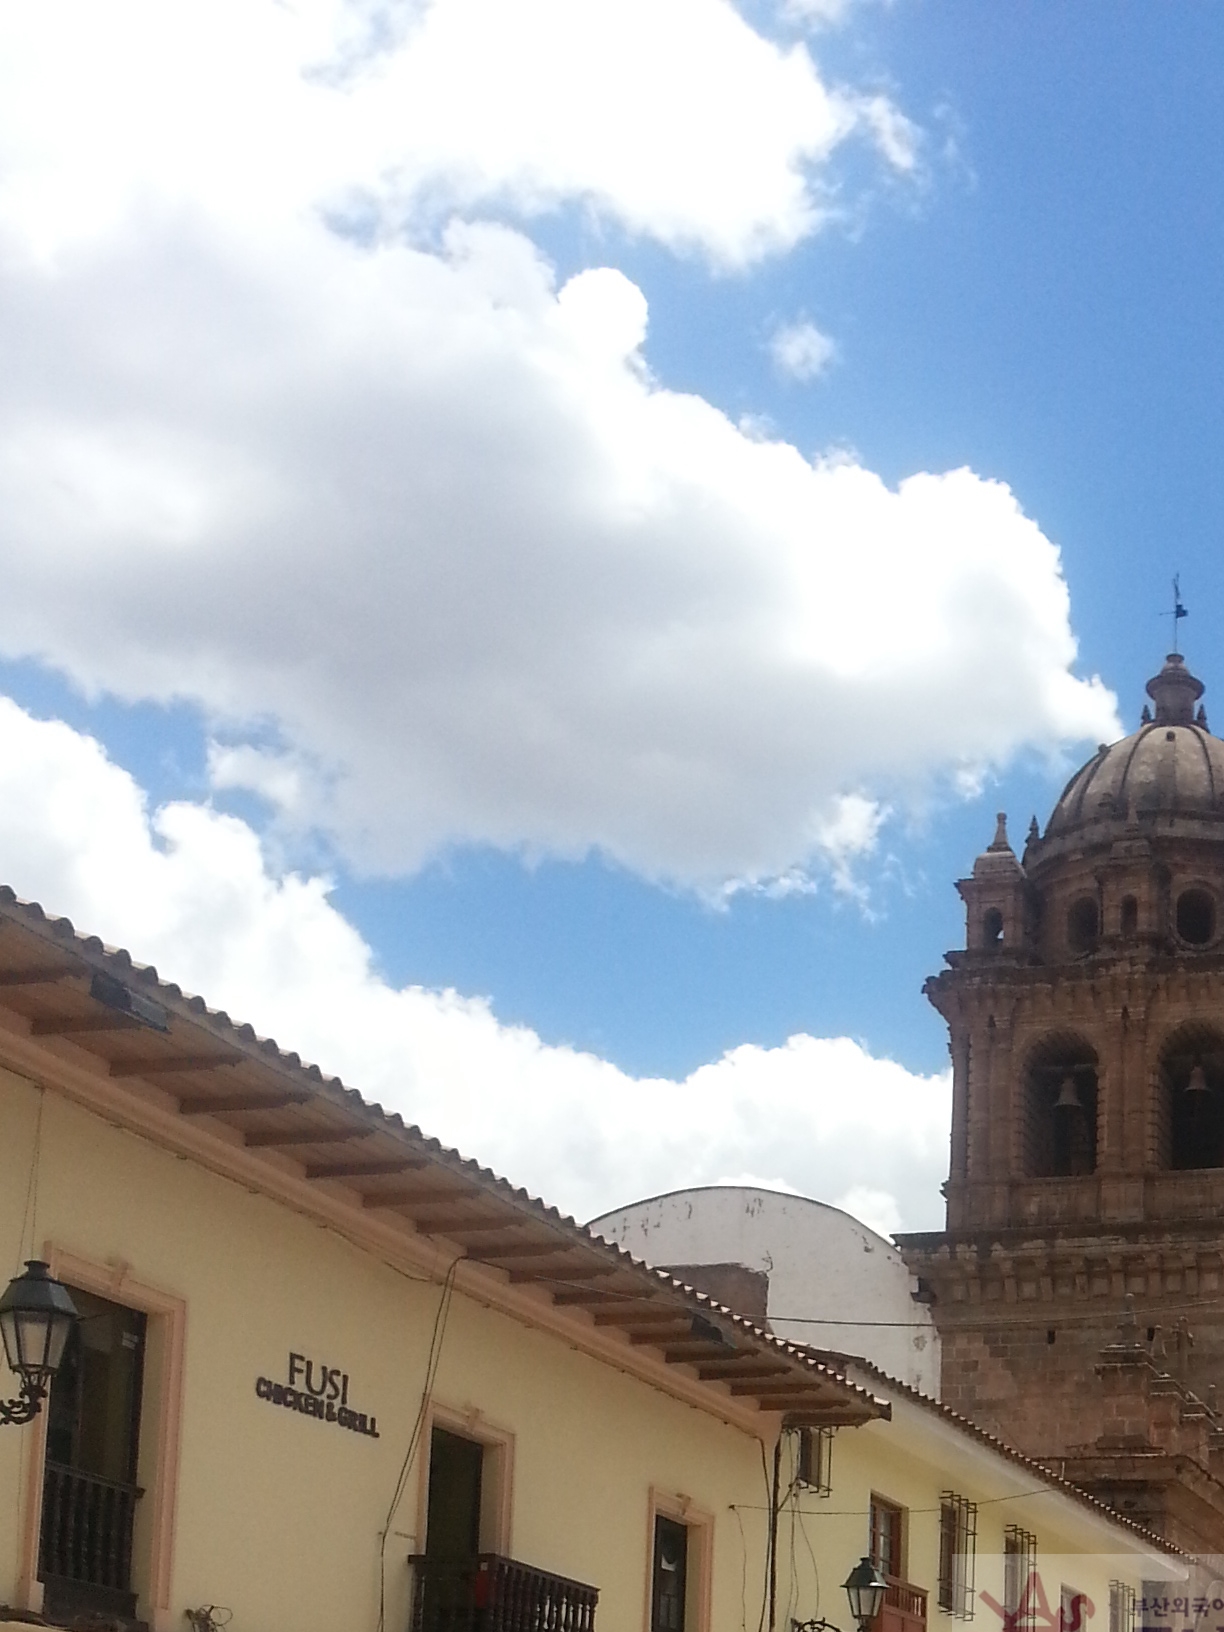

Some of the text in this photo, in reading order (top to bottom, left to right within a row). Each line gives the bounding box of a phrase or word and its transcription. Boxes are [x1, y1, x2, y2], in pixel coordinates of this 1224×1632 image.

[255, 1376, 380, 1438] CHICKEN & GRILL
[289, 1352, 349, 1405] FUSI
